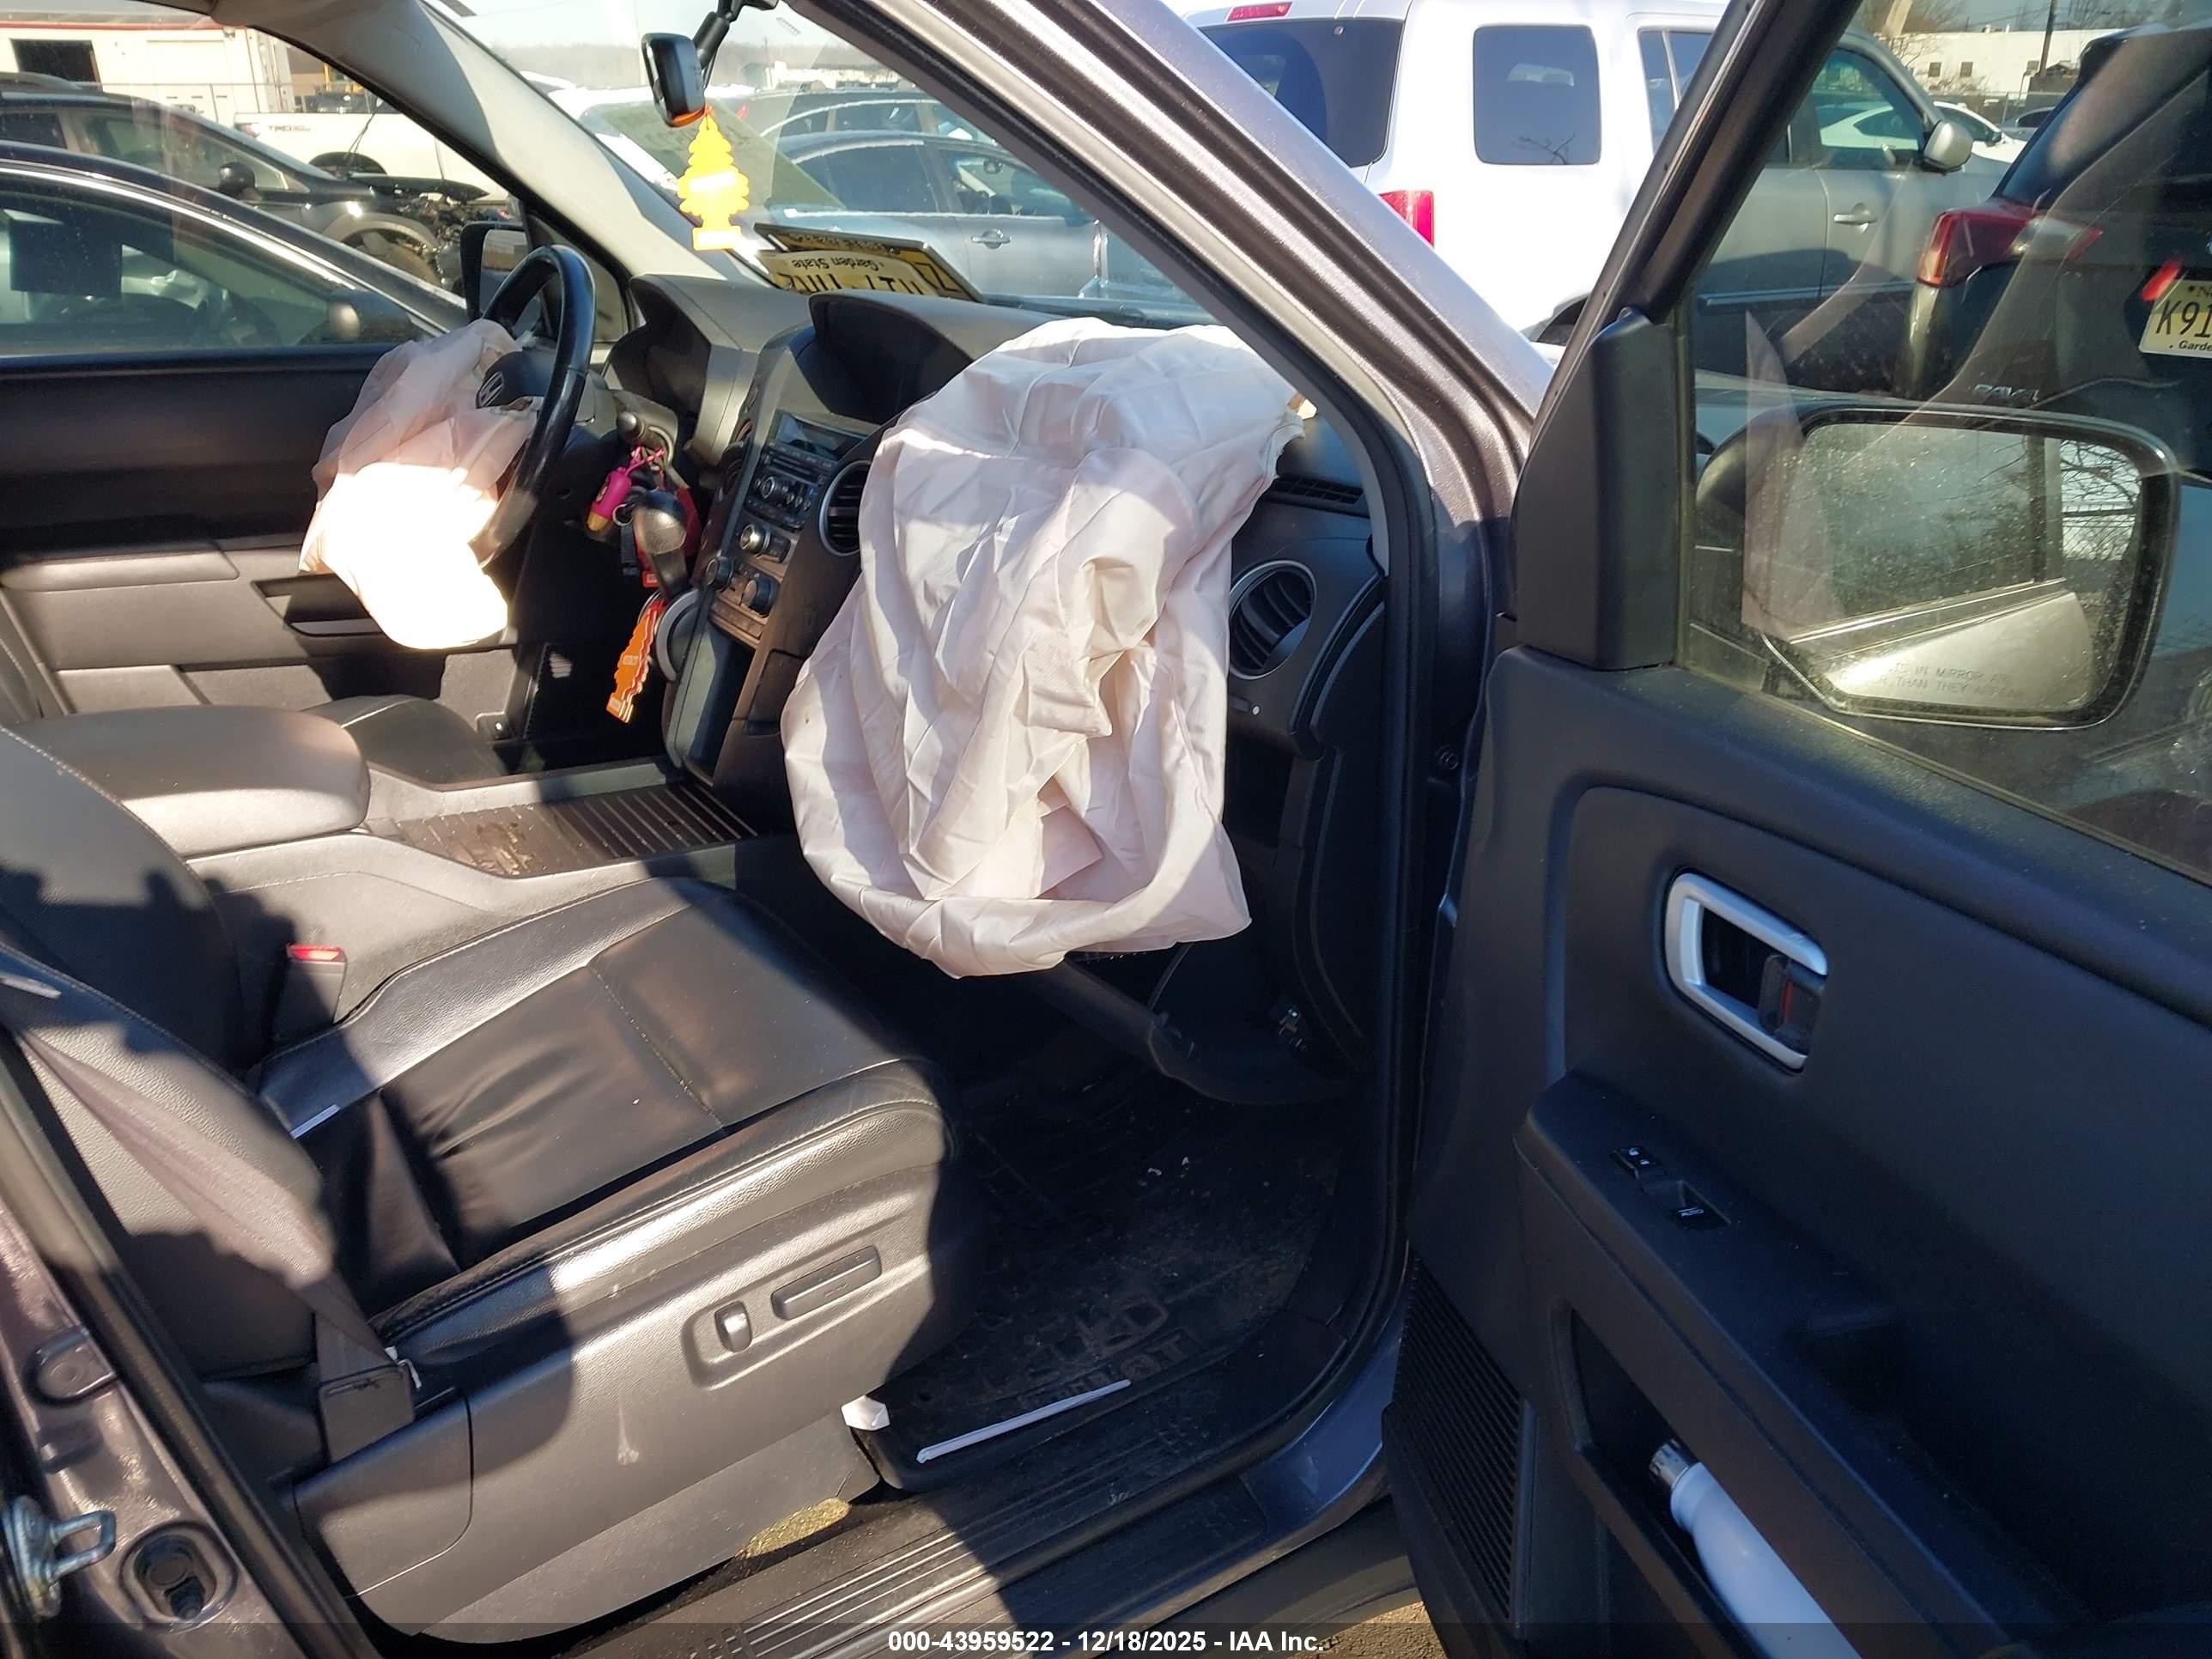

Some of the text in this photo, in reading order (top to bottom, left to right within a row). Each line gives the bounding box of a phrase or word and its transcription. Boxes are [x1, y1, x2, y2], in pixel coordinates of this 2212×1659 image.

[792, 257, 879, 271] Garden State
[1936, 680, 1969, 694] THEY
